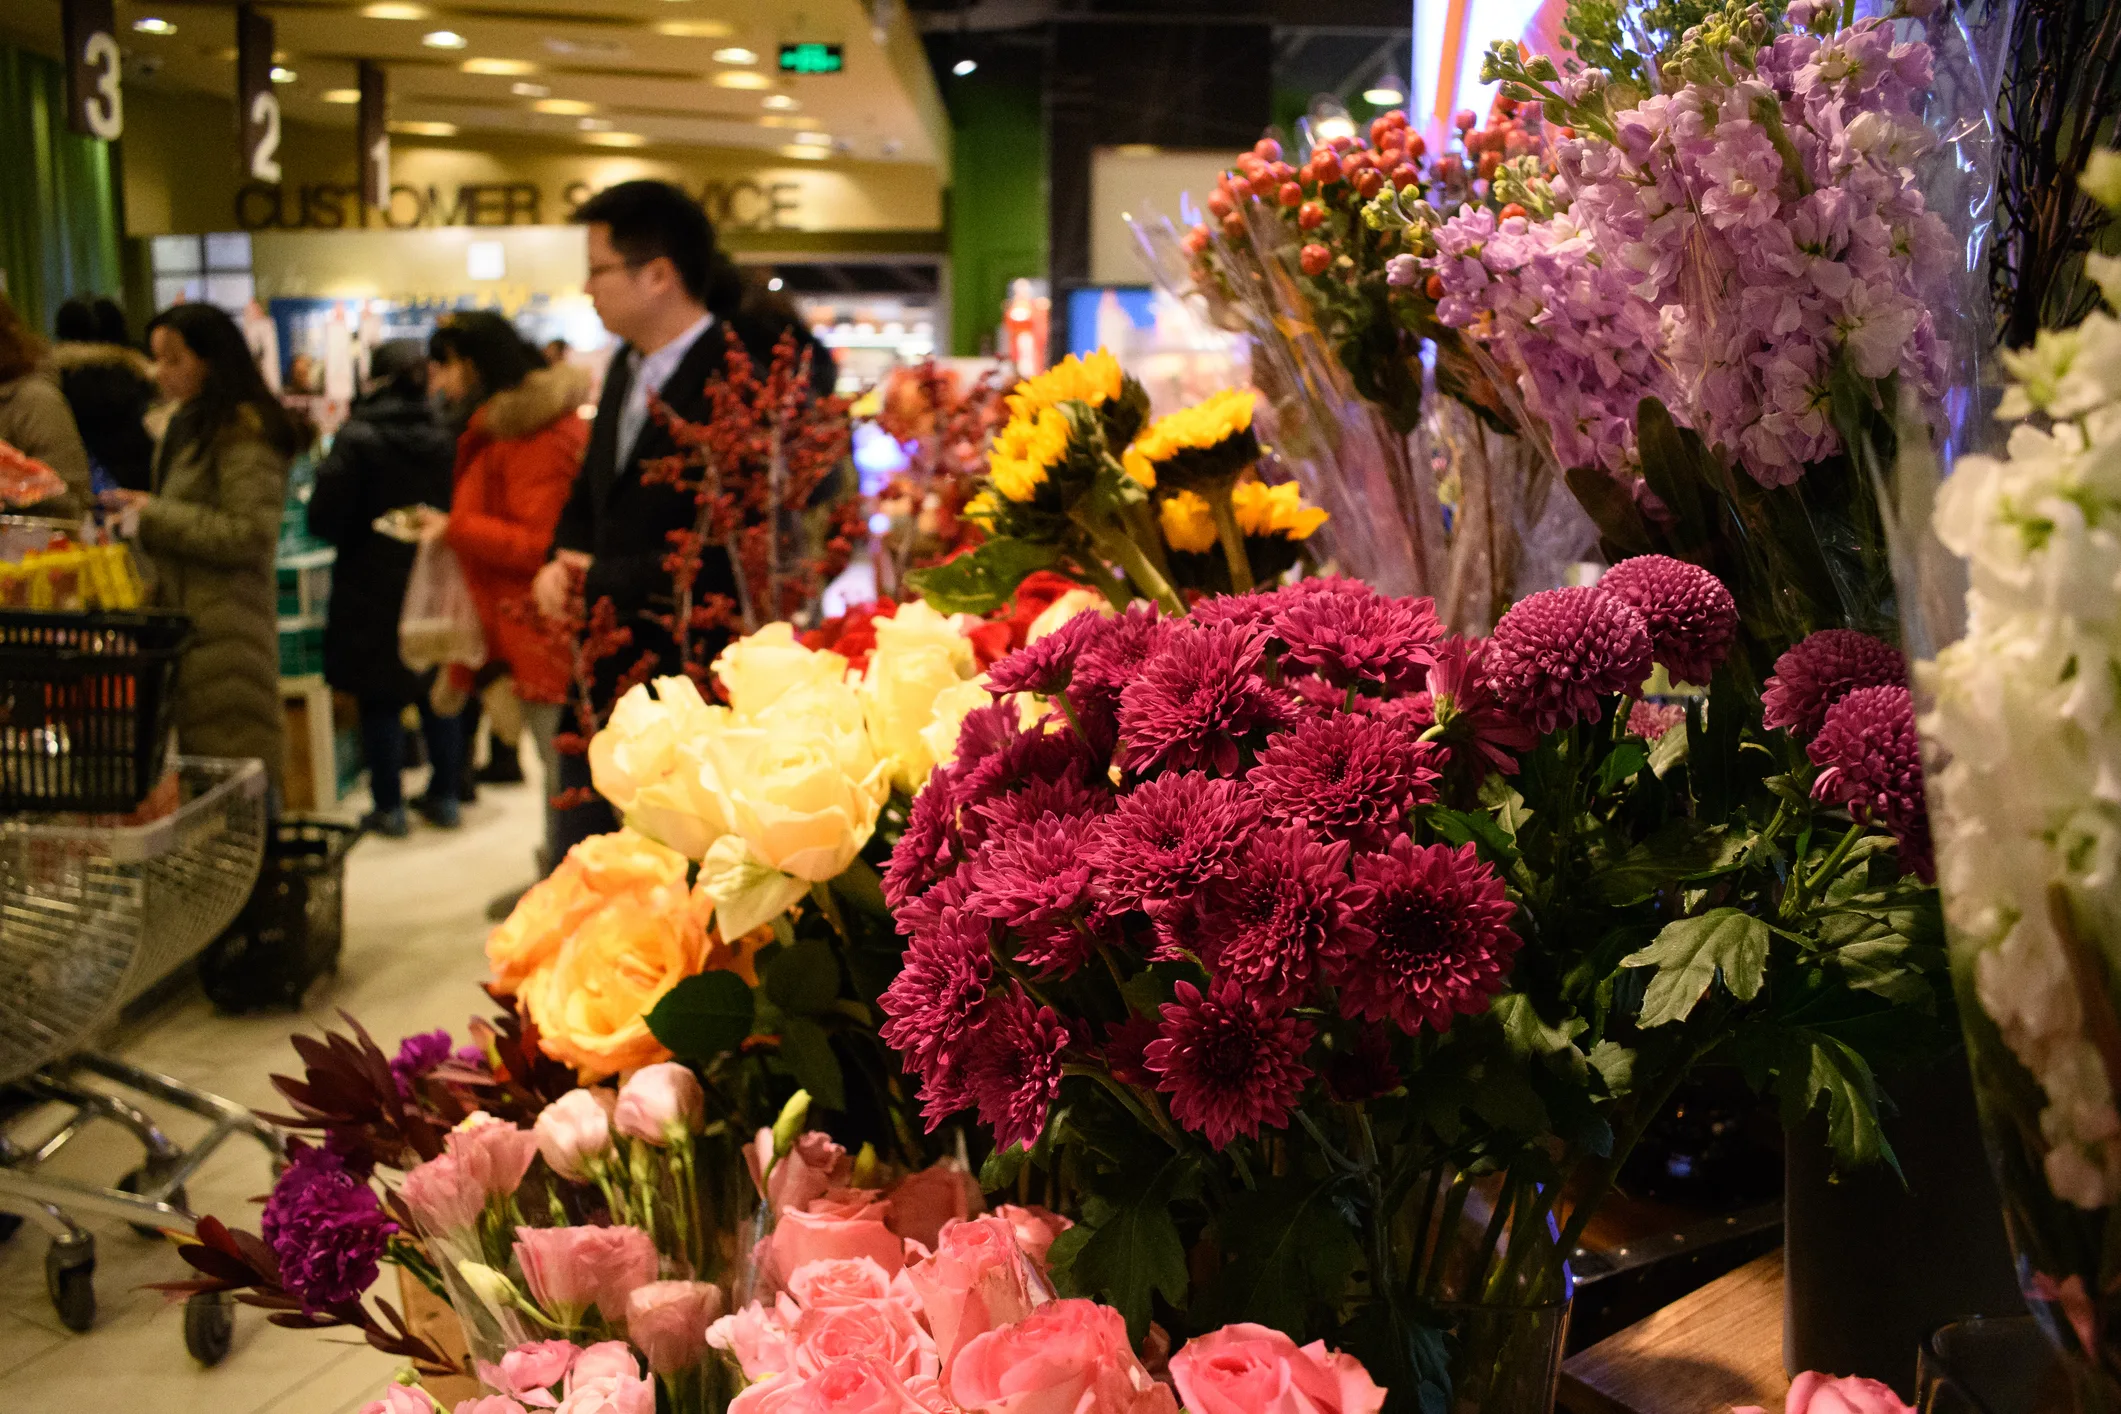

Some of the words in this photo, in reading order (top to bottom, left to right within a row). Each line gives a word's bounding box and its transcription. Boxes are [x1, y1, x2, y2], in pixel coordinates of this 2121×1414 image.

[85, 31, 124, 140] 3
[252, 92, 282, 182] 2
[371, 137, 391, 210] 1
[562, 178, 802, 231] SICE
